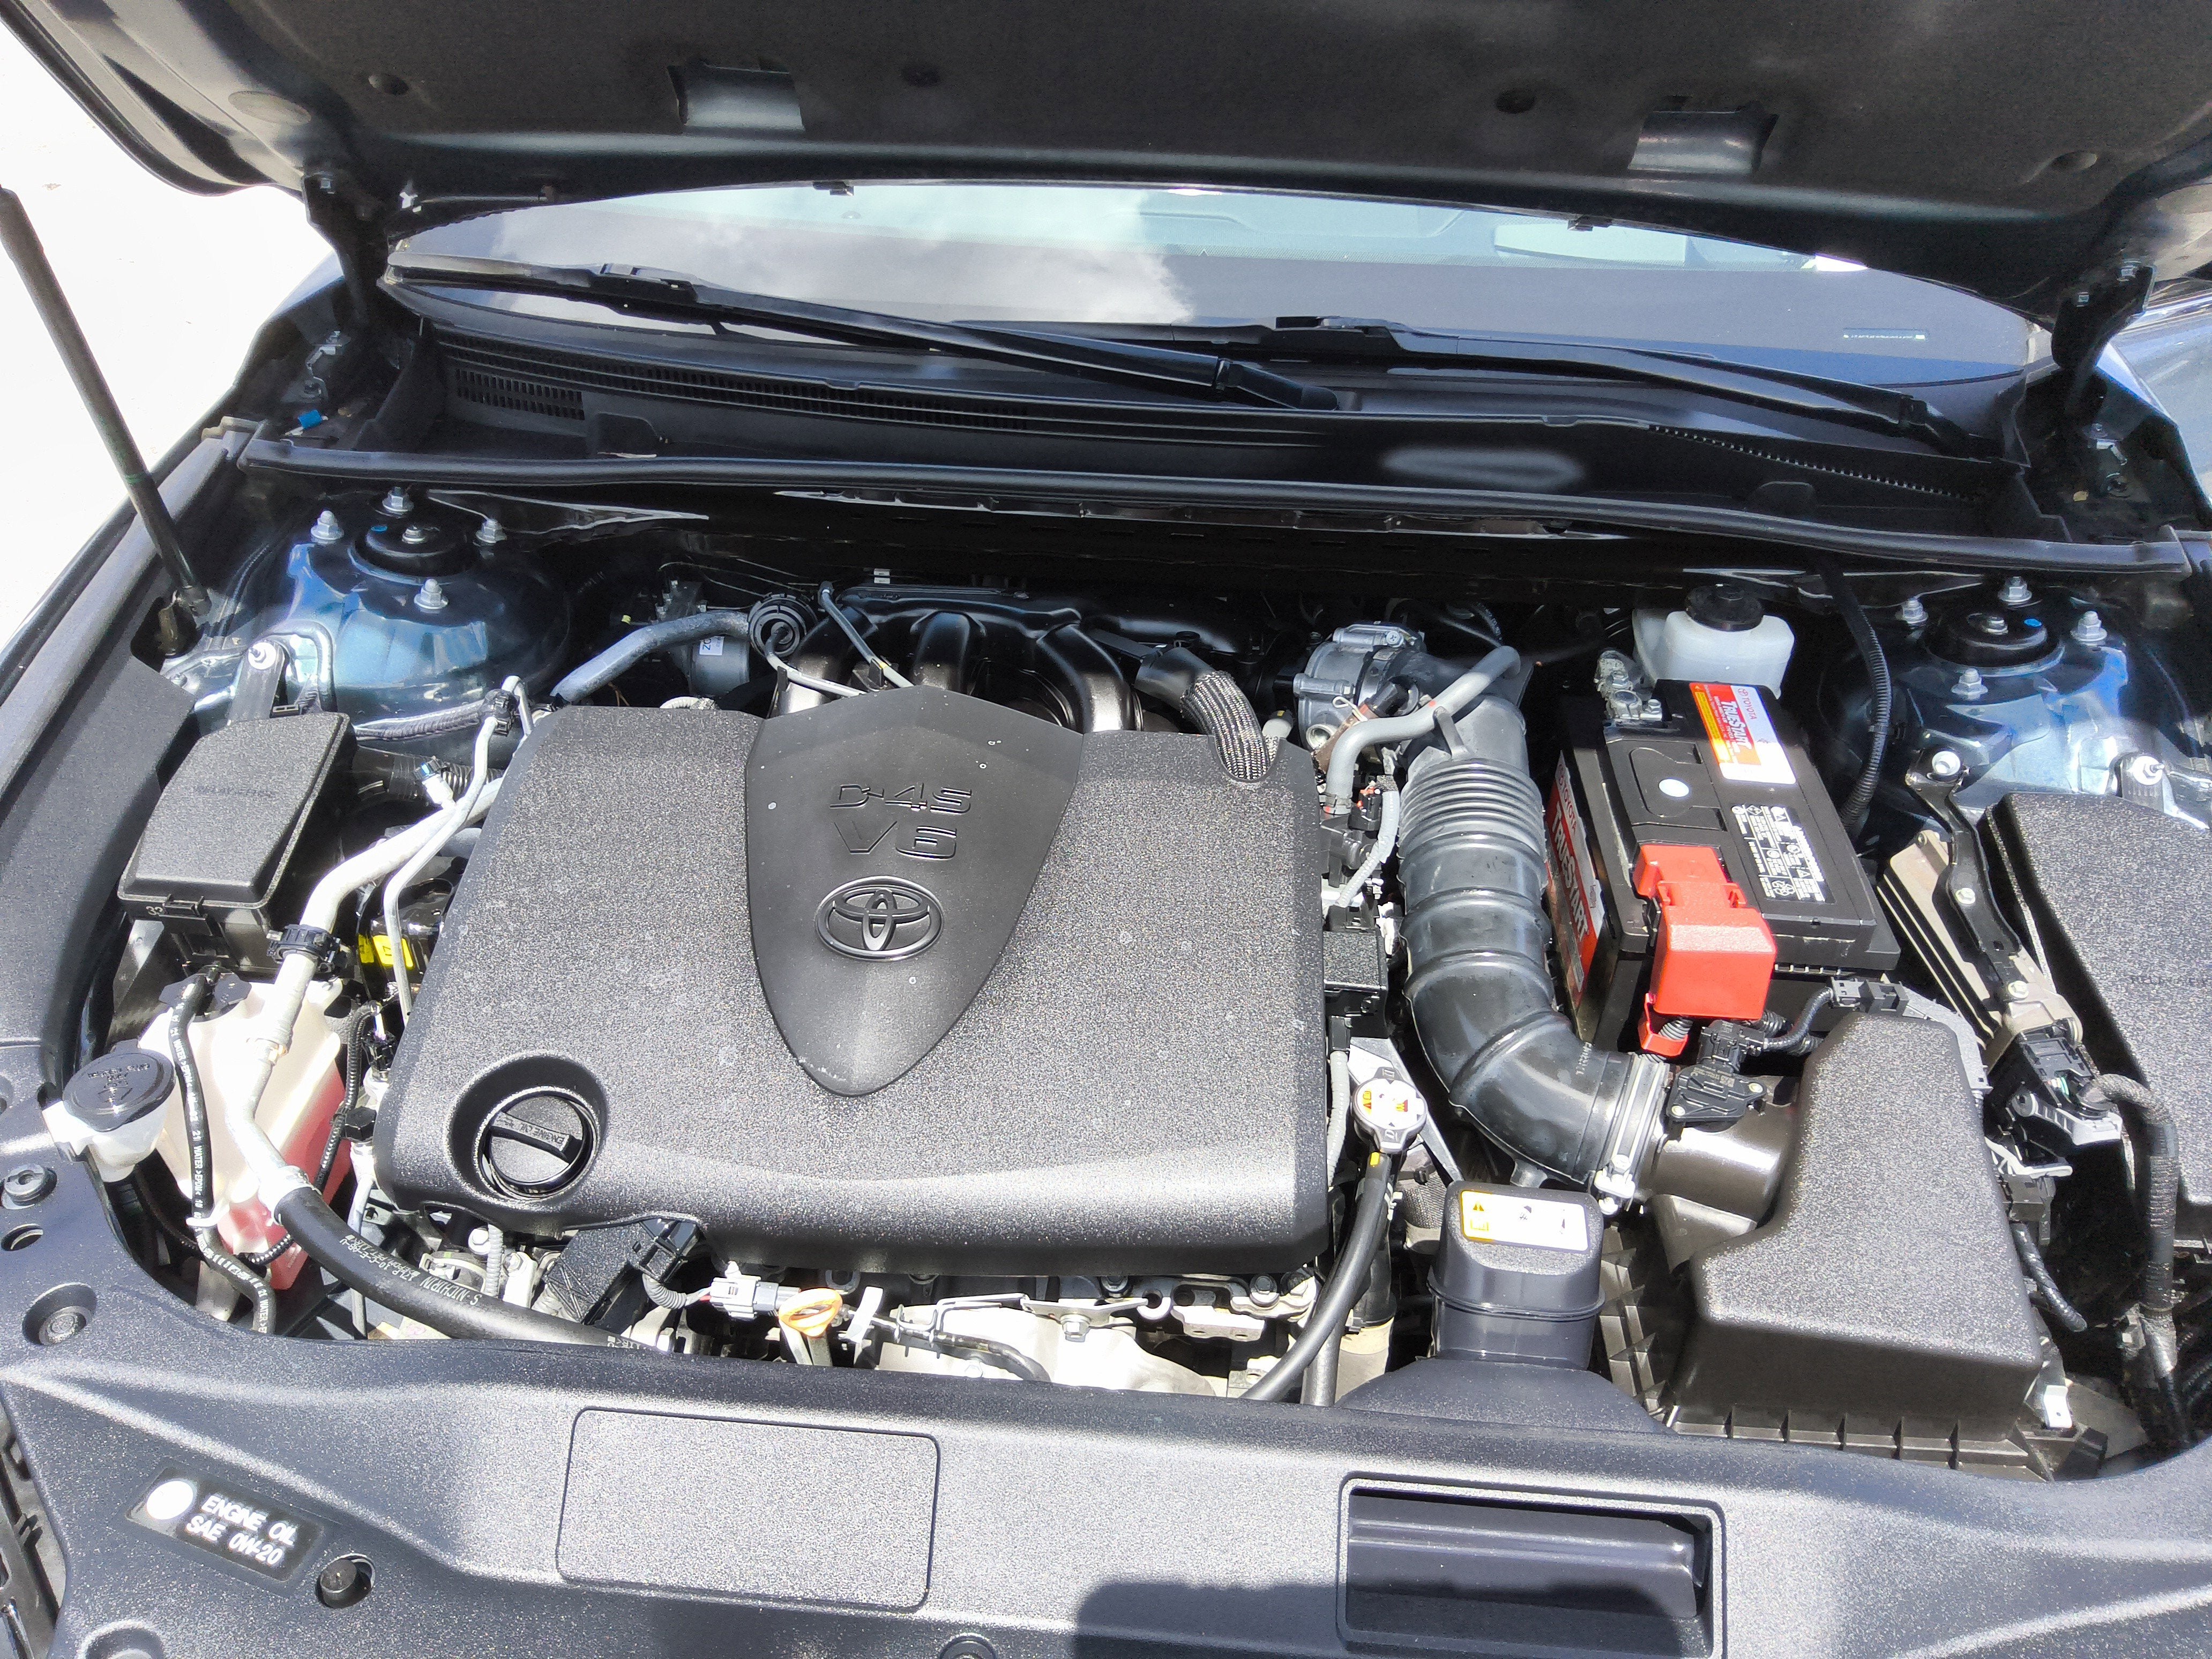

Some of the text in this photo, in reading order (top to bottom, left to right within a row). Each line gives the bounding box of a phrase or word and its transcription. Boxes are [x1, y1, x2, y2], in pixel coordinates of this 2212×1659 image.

[1742, 697, 1757, 720] TOYOTA
[833, 820, 958, 861] V6
[173, 1038, 186, 1062] WATER
[193, 1146, 203, 1170] WATER
[258, 1299, 269, 1327] WATER
[184, 1514, 285, 1566] SAE 0W-20
[201, 1494, 298, 1547] ENGINE OIL
